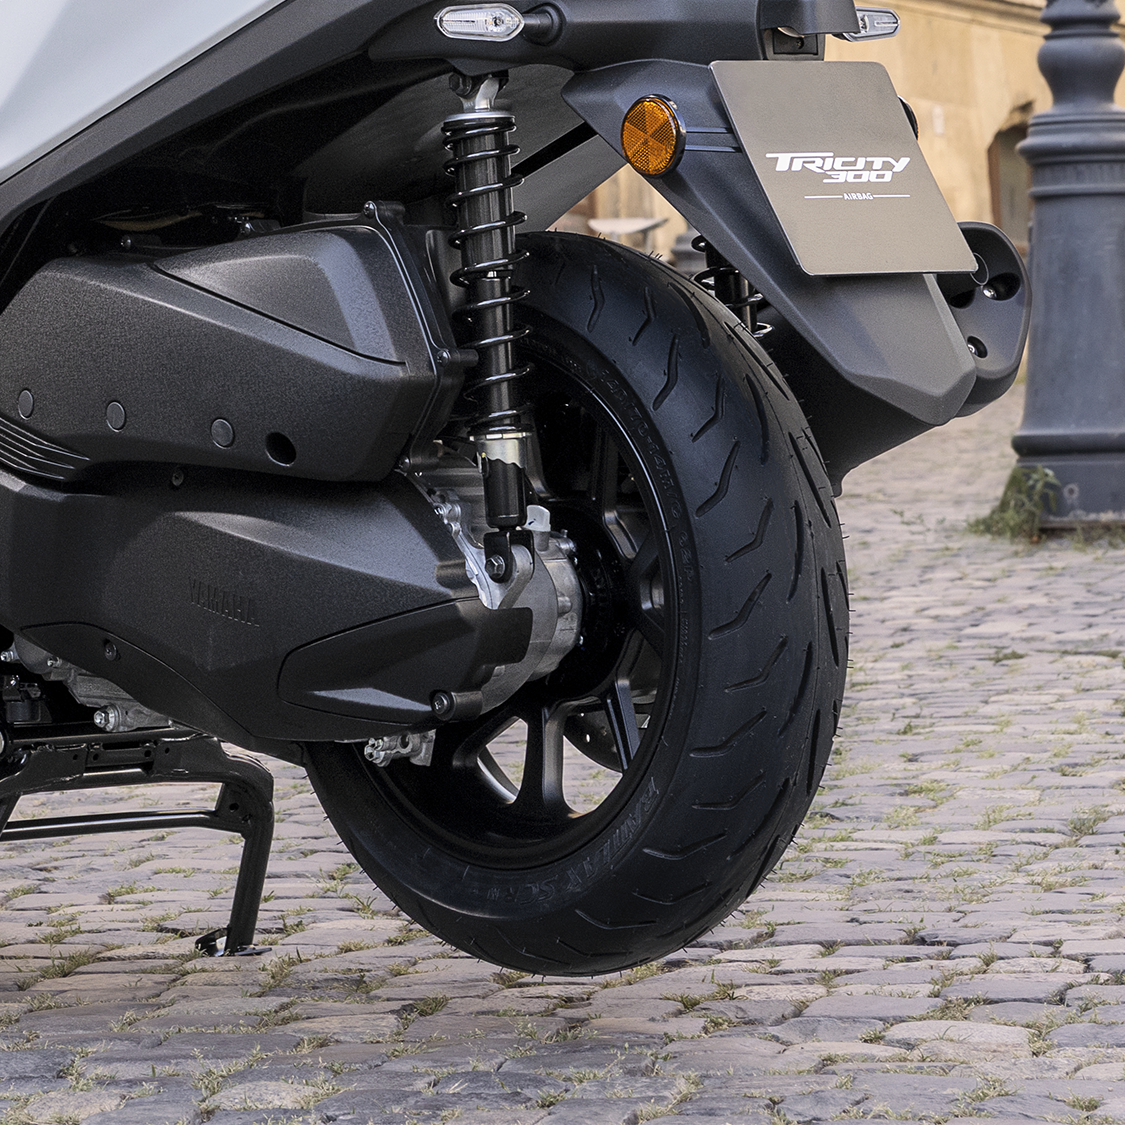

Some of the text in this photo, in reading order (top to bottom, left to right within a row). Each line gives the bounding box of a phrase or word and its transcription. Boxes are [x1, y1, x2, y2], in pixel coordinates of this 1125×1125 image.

[765, 152, 911, 173] TRICITY
[822, 170, 893, 183] 300
[843, 192, 874, 201] AIRBAG
[188, 576, 260, 627] YAMAHA
